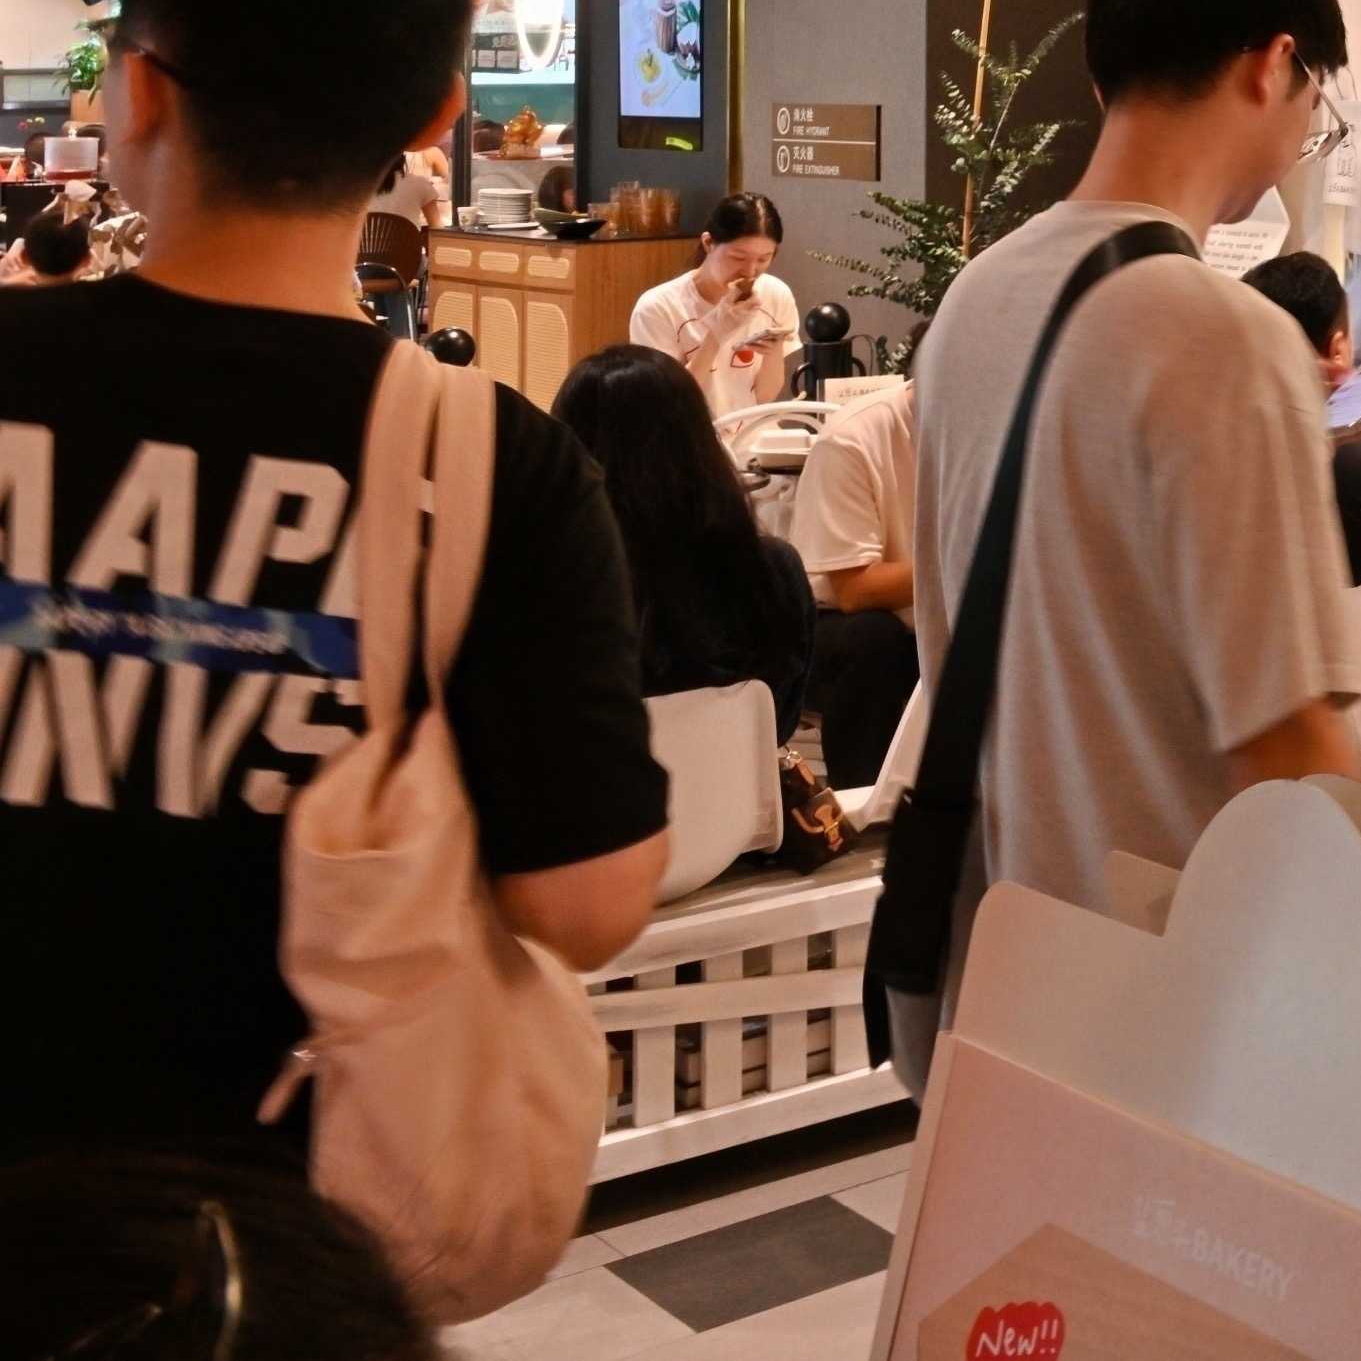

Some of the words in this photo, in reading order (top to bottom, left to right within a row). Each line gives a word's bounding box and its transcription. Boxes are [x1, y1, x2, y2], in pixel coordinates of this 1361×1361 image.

[792, 125, 805, 136] FIRE
[792, 146, 814, 161] 灭火器
[792, 163, 803, 174] FIRE
[1190, 1227, 1295, 1301] BAKERY
[975, 1318, 1059, 1358] New!!
